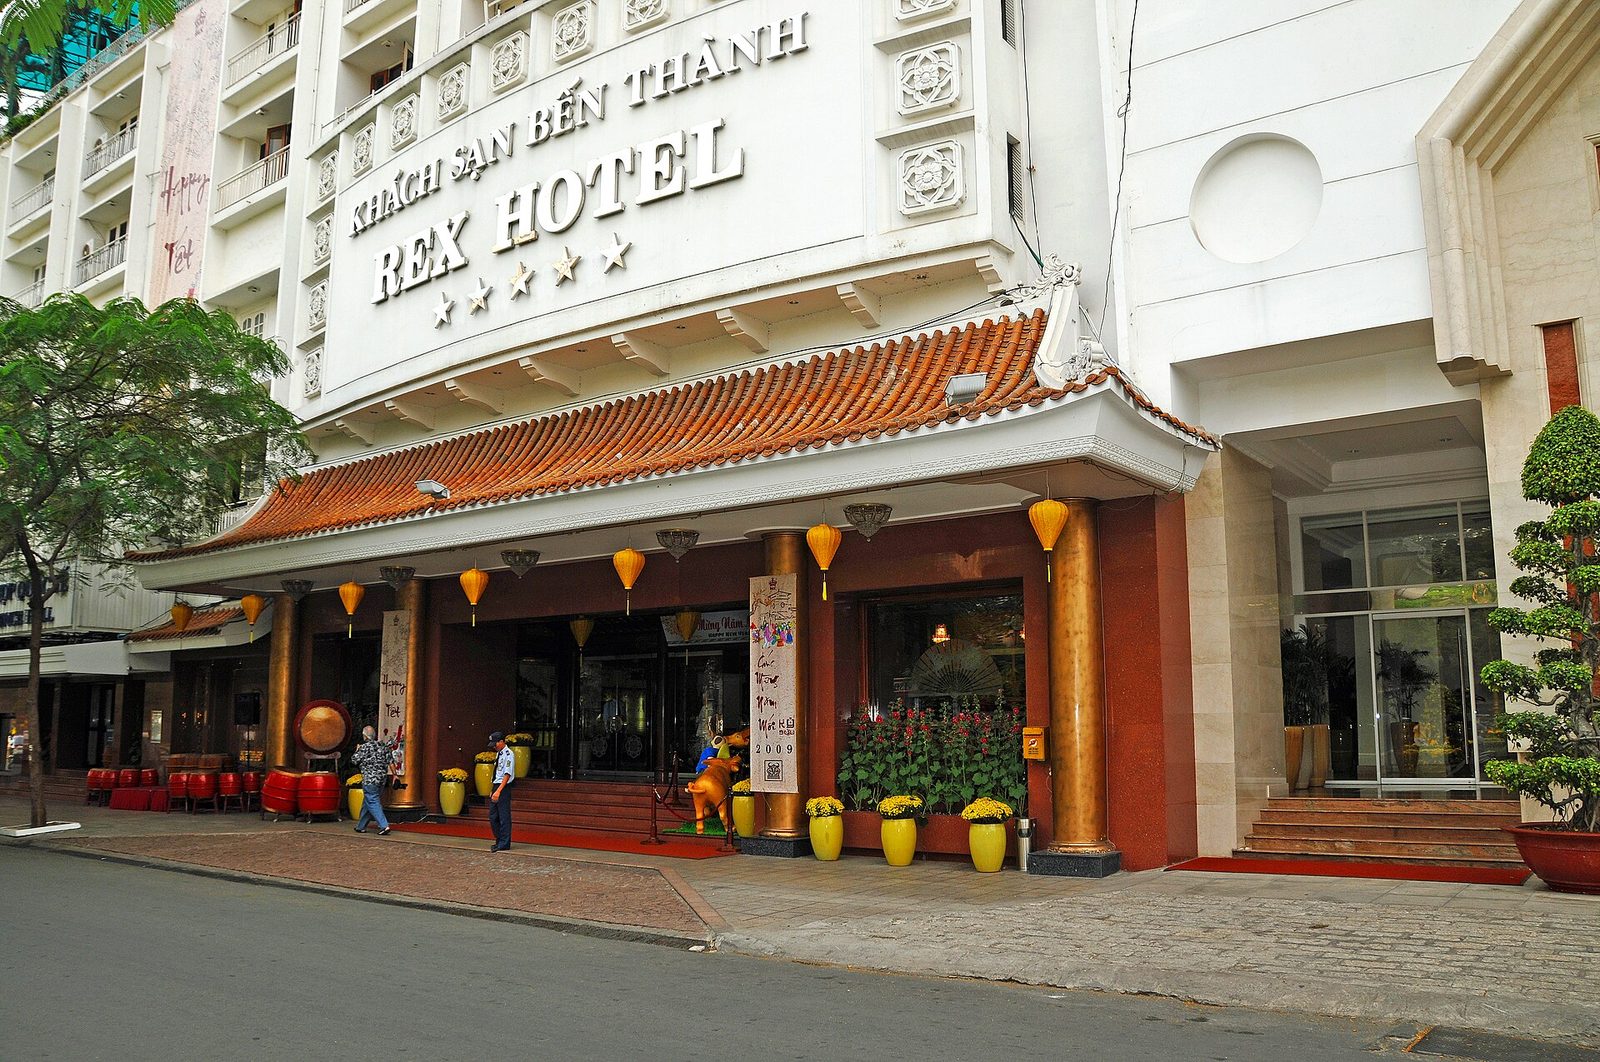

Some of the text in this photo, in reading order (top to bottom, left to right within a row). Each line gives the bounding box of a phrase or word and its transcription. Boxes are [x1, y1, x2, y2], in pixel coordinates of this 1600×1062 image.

[347, 11, 809, 238] KHÁCH SẠN BẾN THÀNH
[160, 165, 210, 216] Happy
[370, 118, 744, 306] REX HOTEL
[721, 616, 744, 629] Năm
[755, 744, 793, 755] 2009
